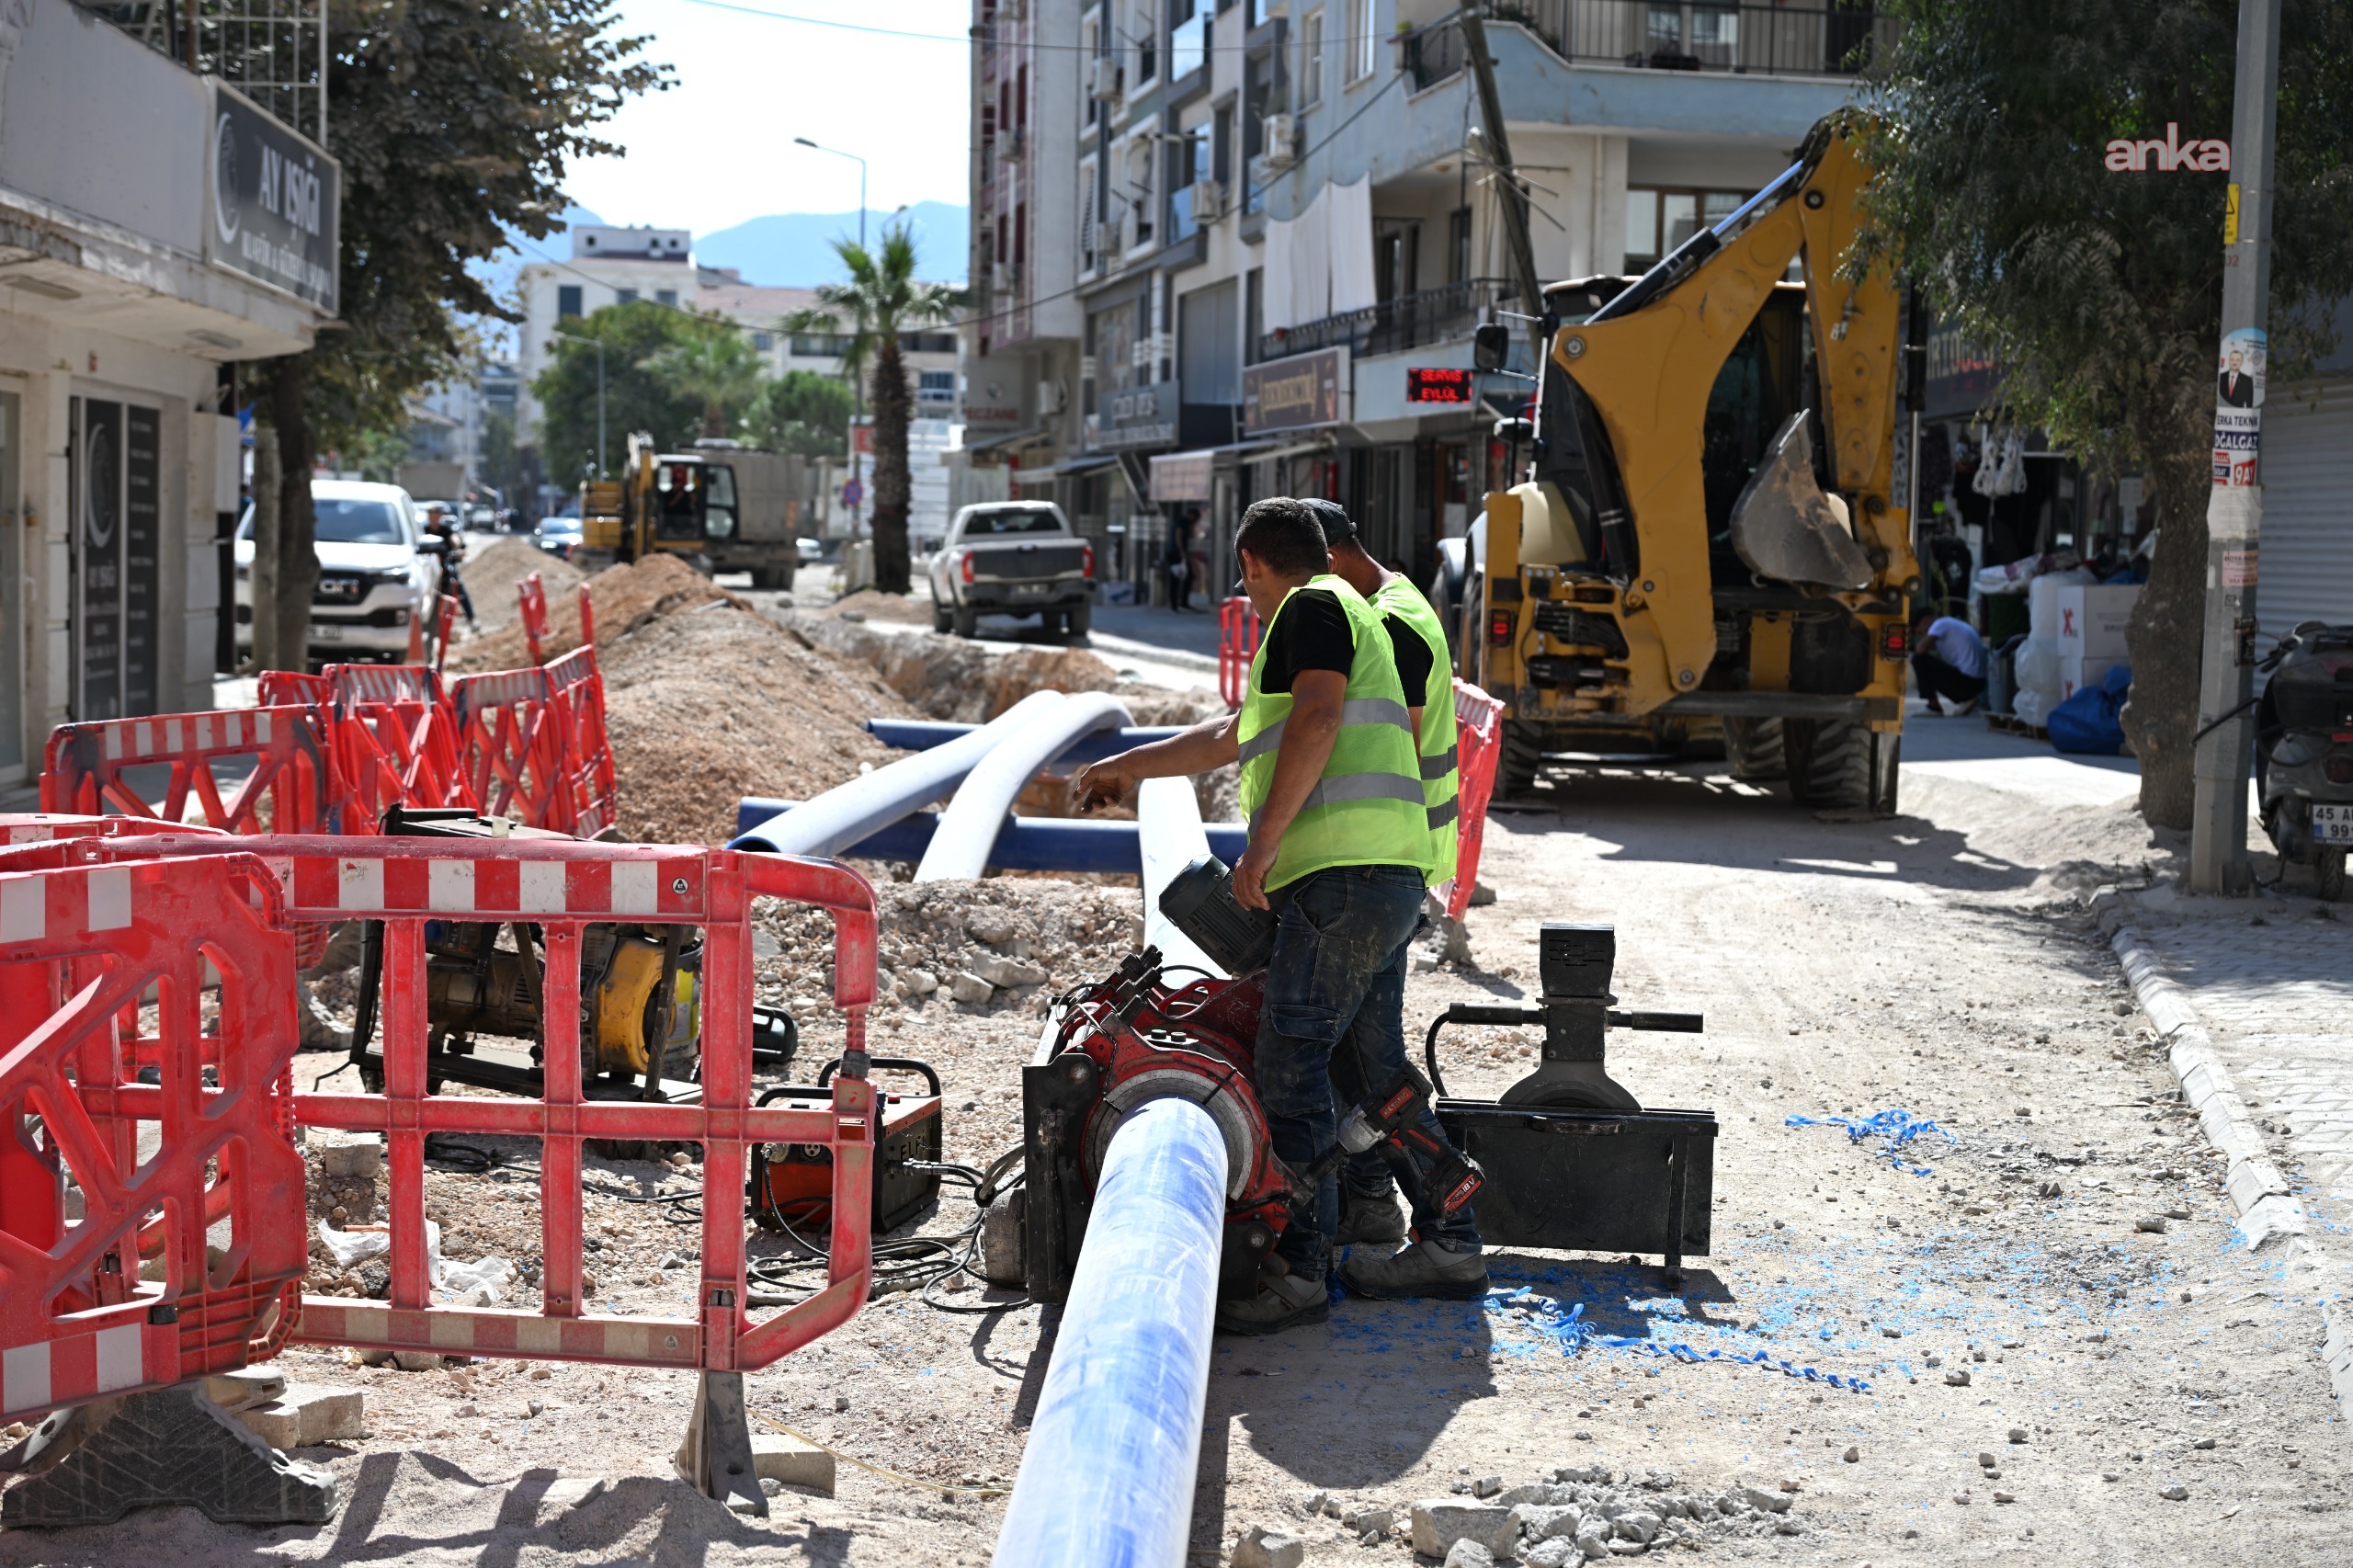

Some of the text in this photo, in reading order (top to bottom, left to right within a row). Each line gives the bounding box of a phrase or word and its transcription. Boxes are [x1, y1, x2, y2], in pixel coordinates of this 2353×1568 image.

[258, 145, 283, 215] AY
[2316, 807, 2353, 822] 45 A
[2331, 824, 2353, 837] 99
